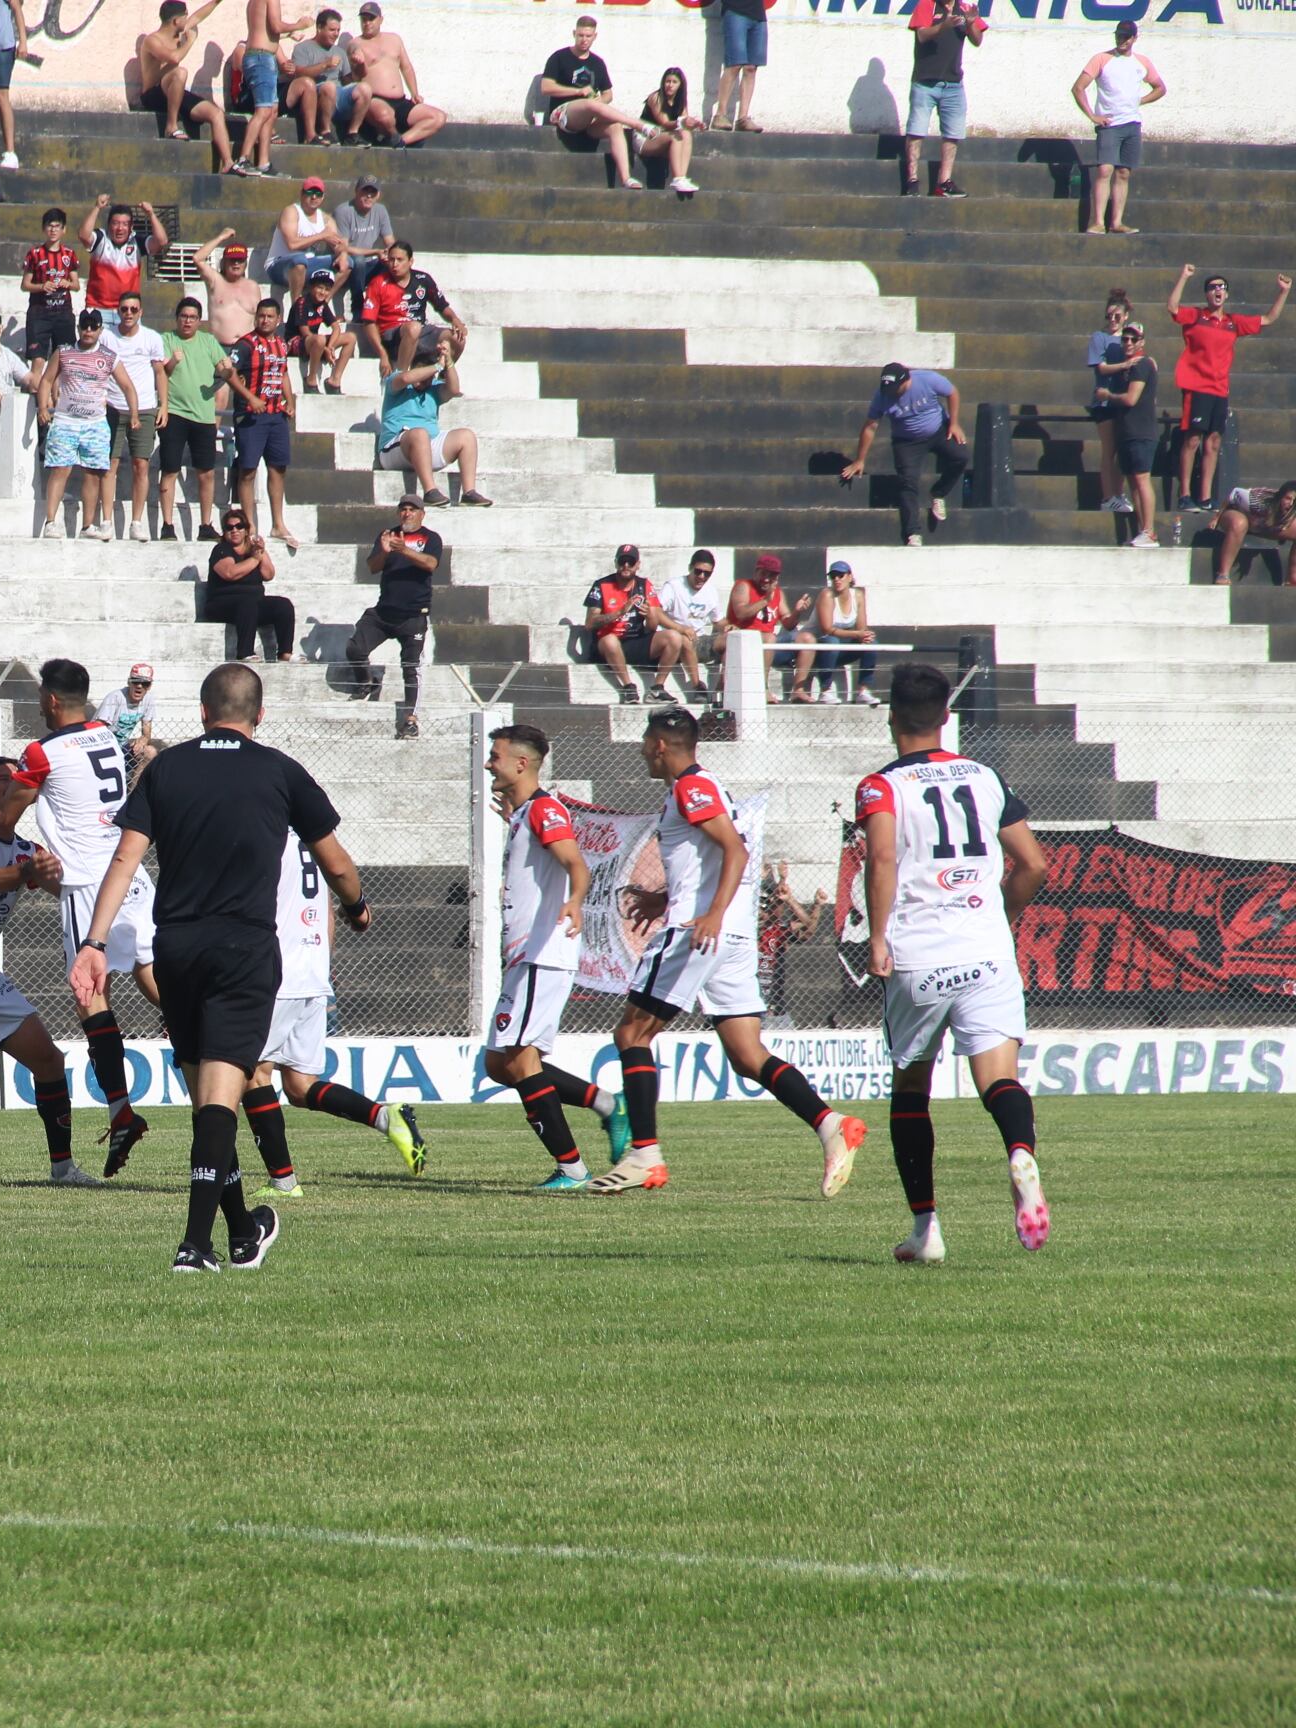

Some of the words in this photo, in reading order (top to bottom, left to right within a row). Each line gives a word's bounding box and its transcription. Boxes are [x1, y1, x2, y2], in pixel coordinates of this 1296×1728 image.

[86, 746, 124, 804] 5
[922, 784, 988, 859] 11
[298, 840, 319, 899] 8
[936, 968, 981, 991] PABLO
[798, 1039, 814, 1067] DE
[815, 1038, 867, 1067] OCTUBRE
[1017, 1039, 1286, 1098] ESCAPES
